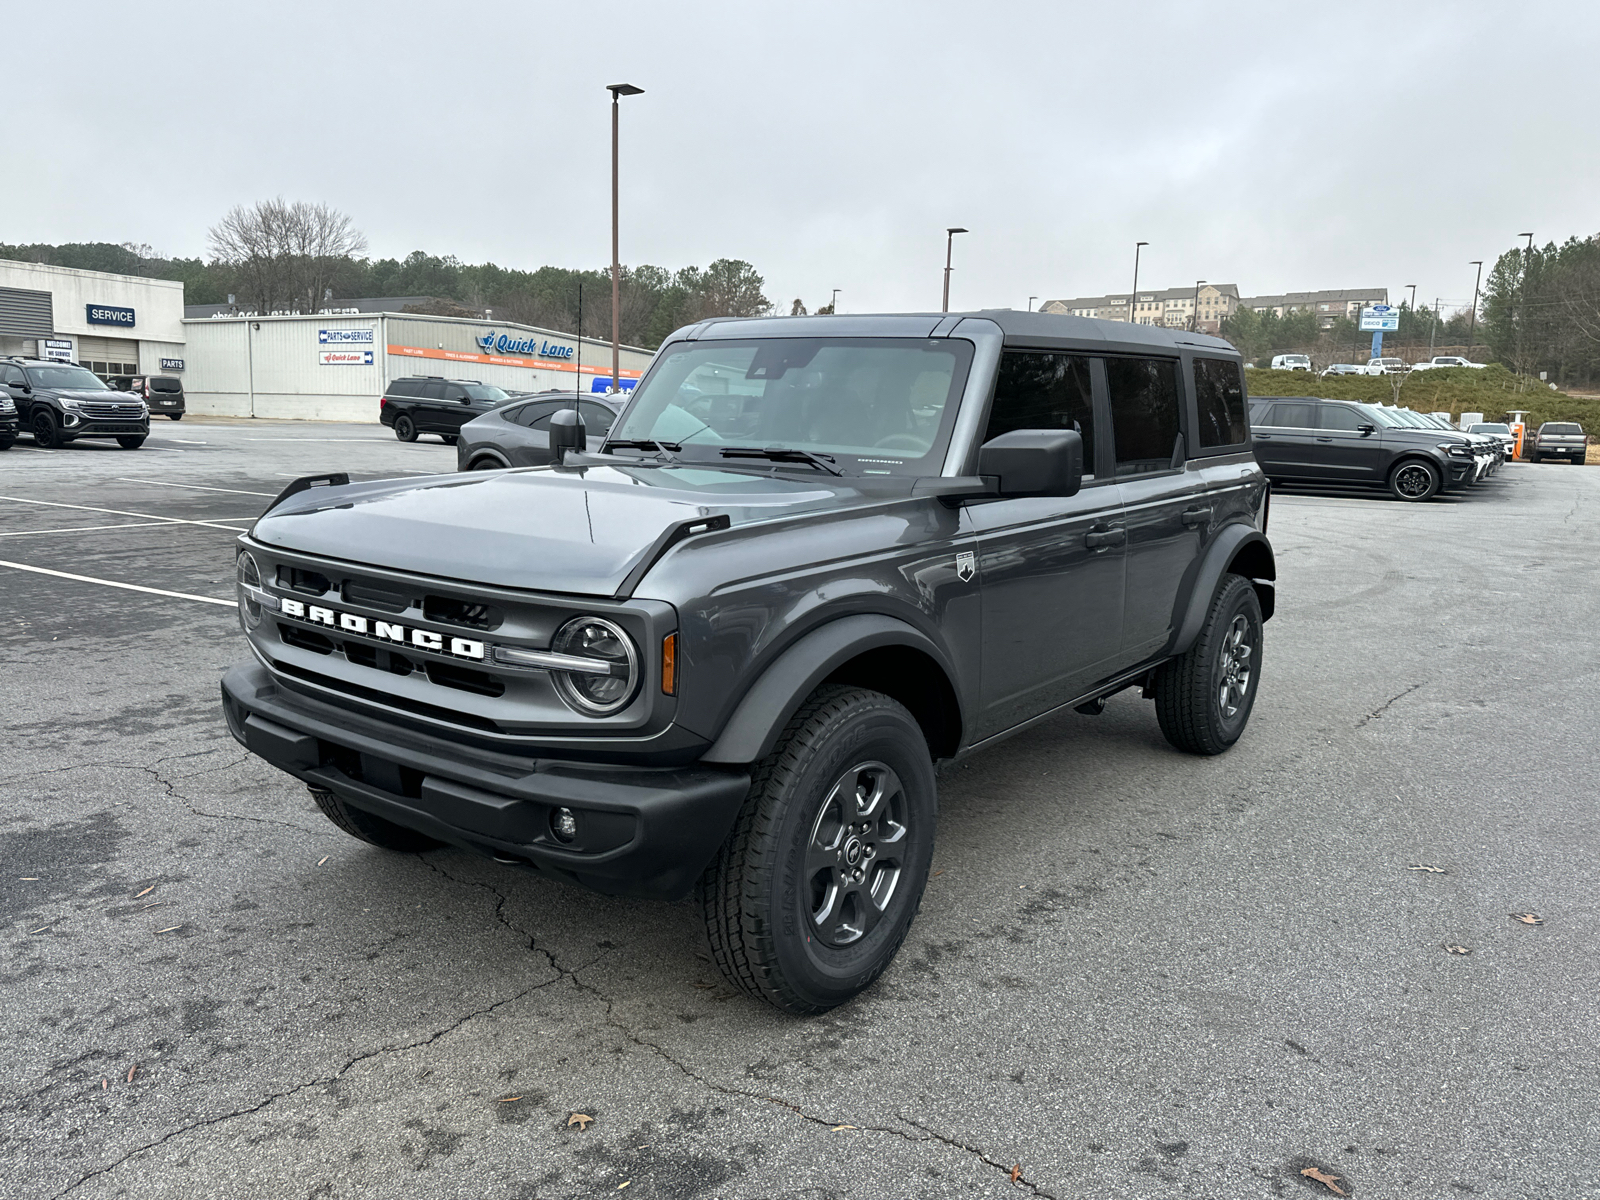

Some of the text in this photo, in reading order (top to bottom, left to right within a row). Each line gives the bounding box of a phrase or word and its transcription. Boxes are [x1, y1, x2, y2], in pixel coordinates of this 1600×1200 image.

[91, 308, 133, 322] SERVICE
[327, 331, 343, 341] PARTS
[350, 331, 372, 341] SERVICE
[496, 334, 574, 358] Quick Lane
[162, 360, 183, 369] PARTS
[281, 597, 484, 659] BRONCO
